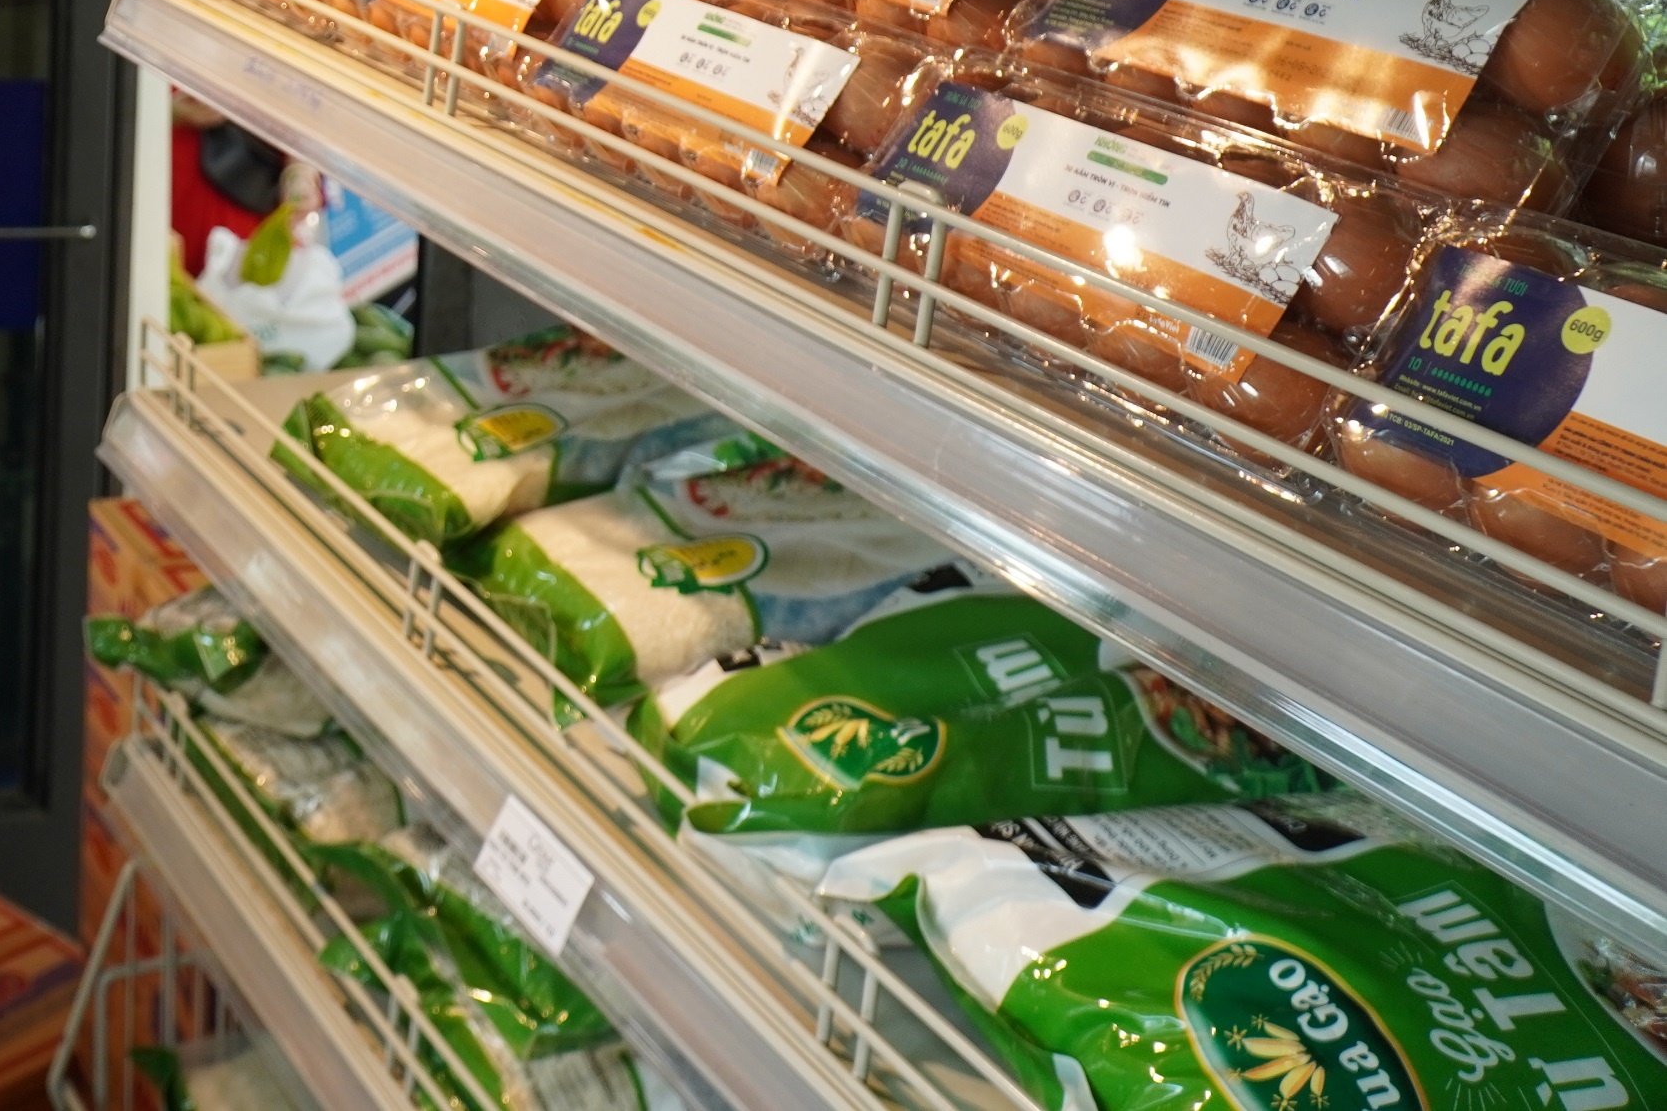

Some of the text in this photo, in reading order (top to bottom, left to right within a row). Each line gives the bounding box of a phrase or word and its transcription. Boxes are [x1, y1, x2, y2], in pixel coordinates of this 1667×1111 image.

[907, 109, 976, 170] tafa
[1002, 124, 1023, 140] 600g
[1419, 289, 1525, 376] tafa
[1569, 318, 1604, 343] 600g
[1397, 889, 1567, 1031] Tâm
[1269, 958, 1348, 1042] Gạo
